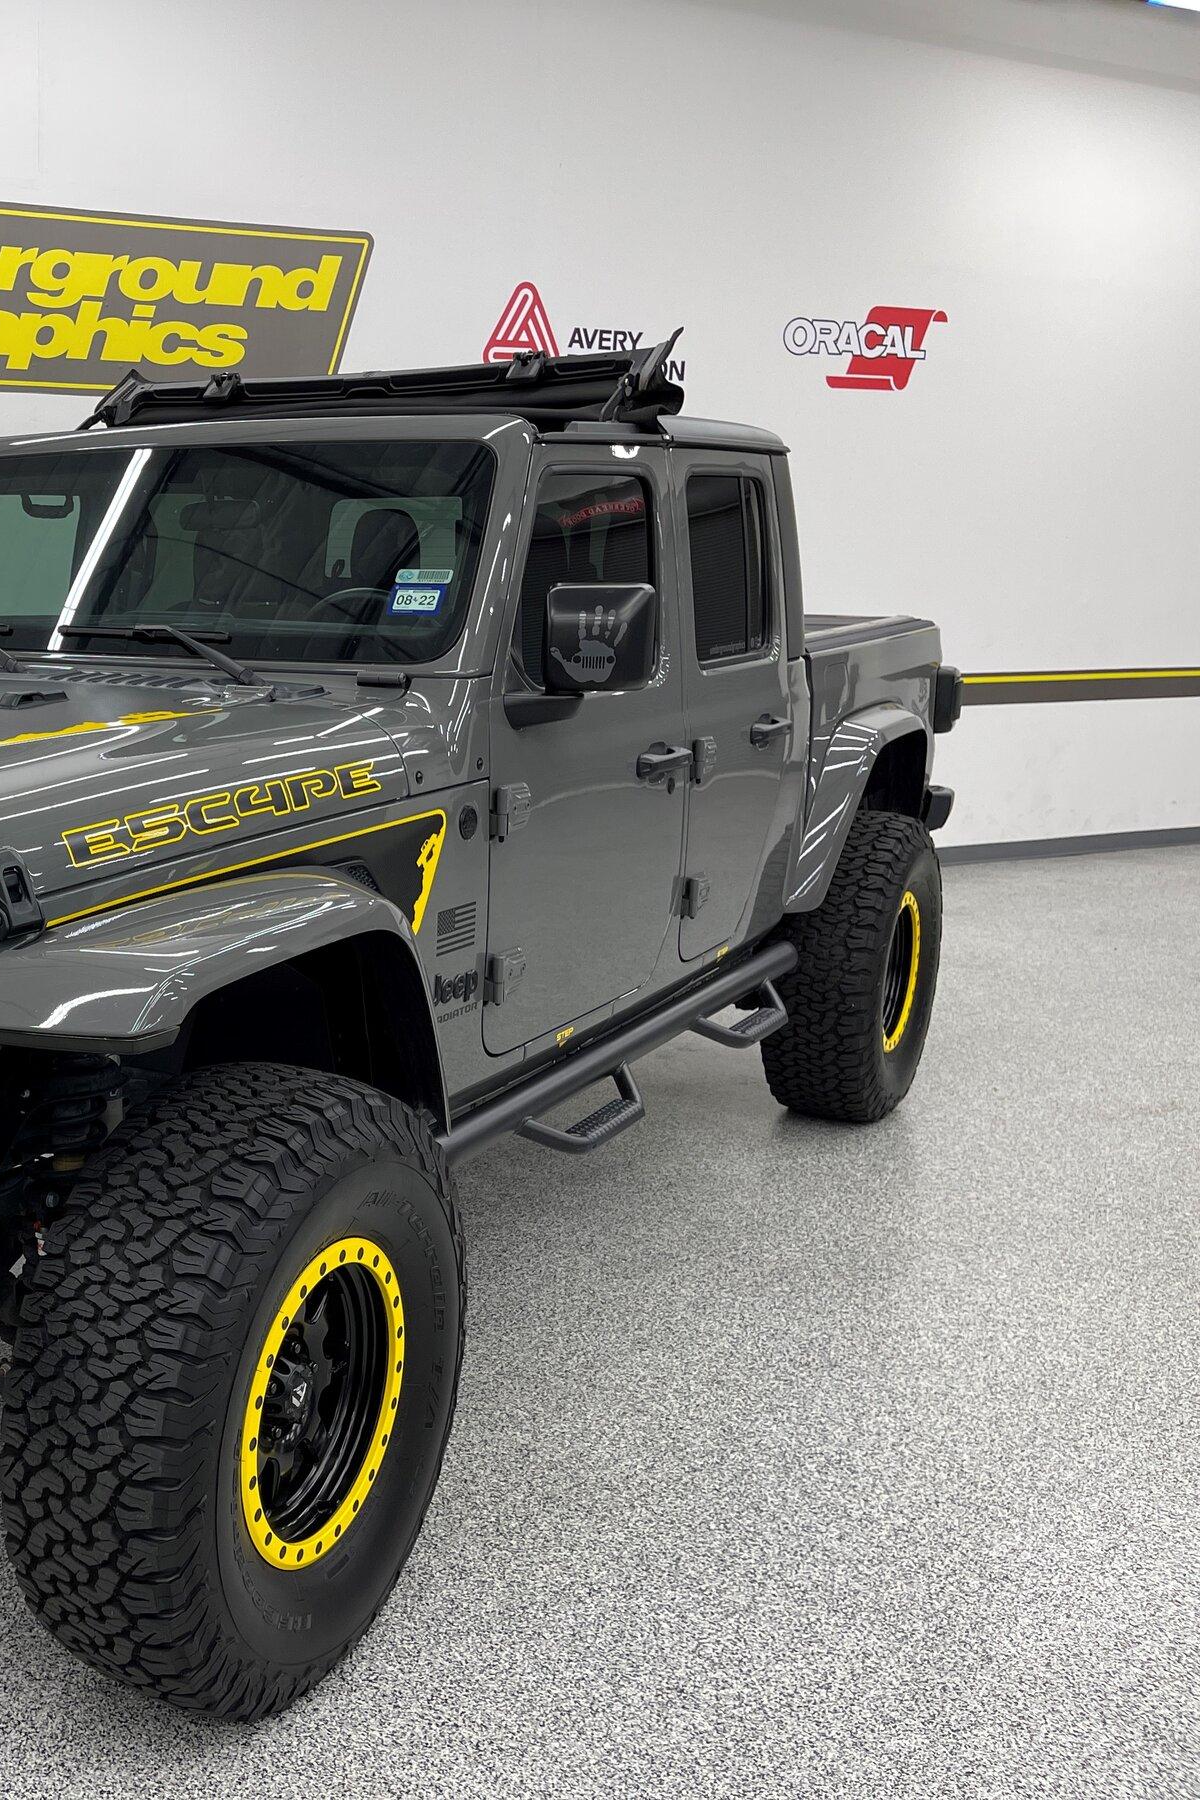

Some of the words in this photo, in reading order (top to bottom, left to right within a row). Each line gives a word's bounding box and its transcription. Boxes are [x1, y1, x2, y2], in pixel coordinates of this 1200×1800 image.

[567, 326, 644, 352] AVERY
[782, 316, 927, 361] ORACAL
[396, 594, 413, 606] 08
[418, 595, 436, 606] 22
[433, 969, 479, 1007] Jeep
[436, 1001, 478, 1024] ADIATOR
[556, 1026, 575, 1042] STEP
